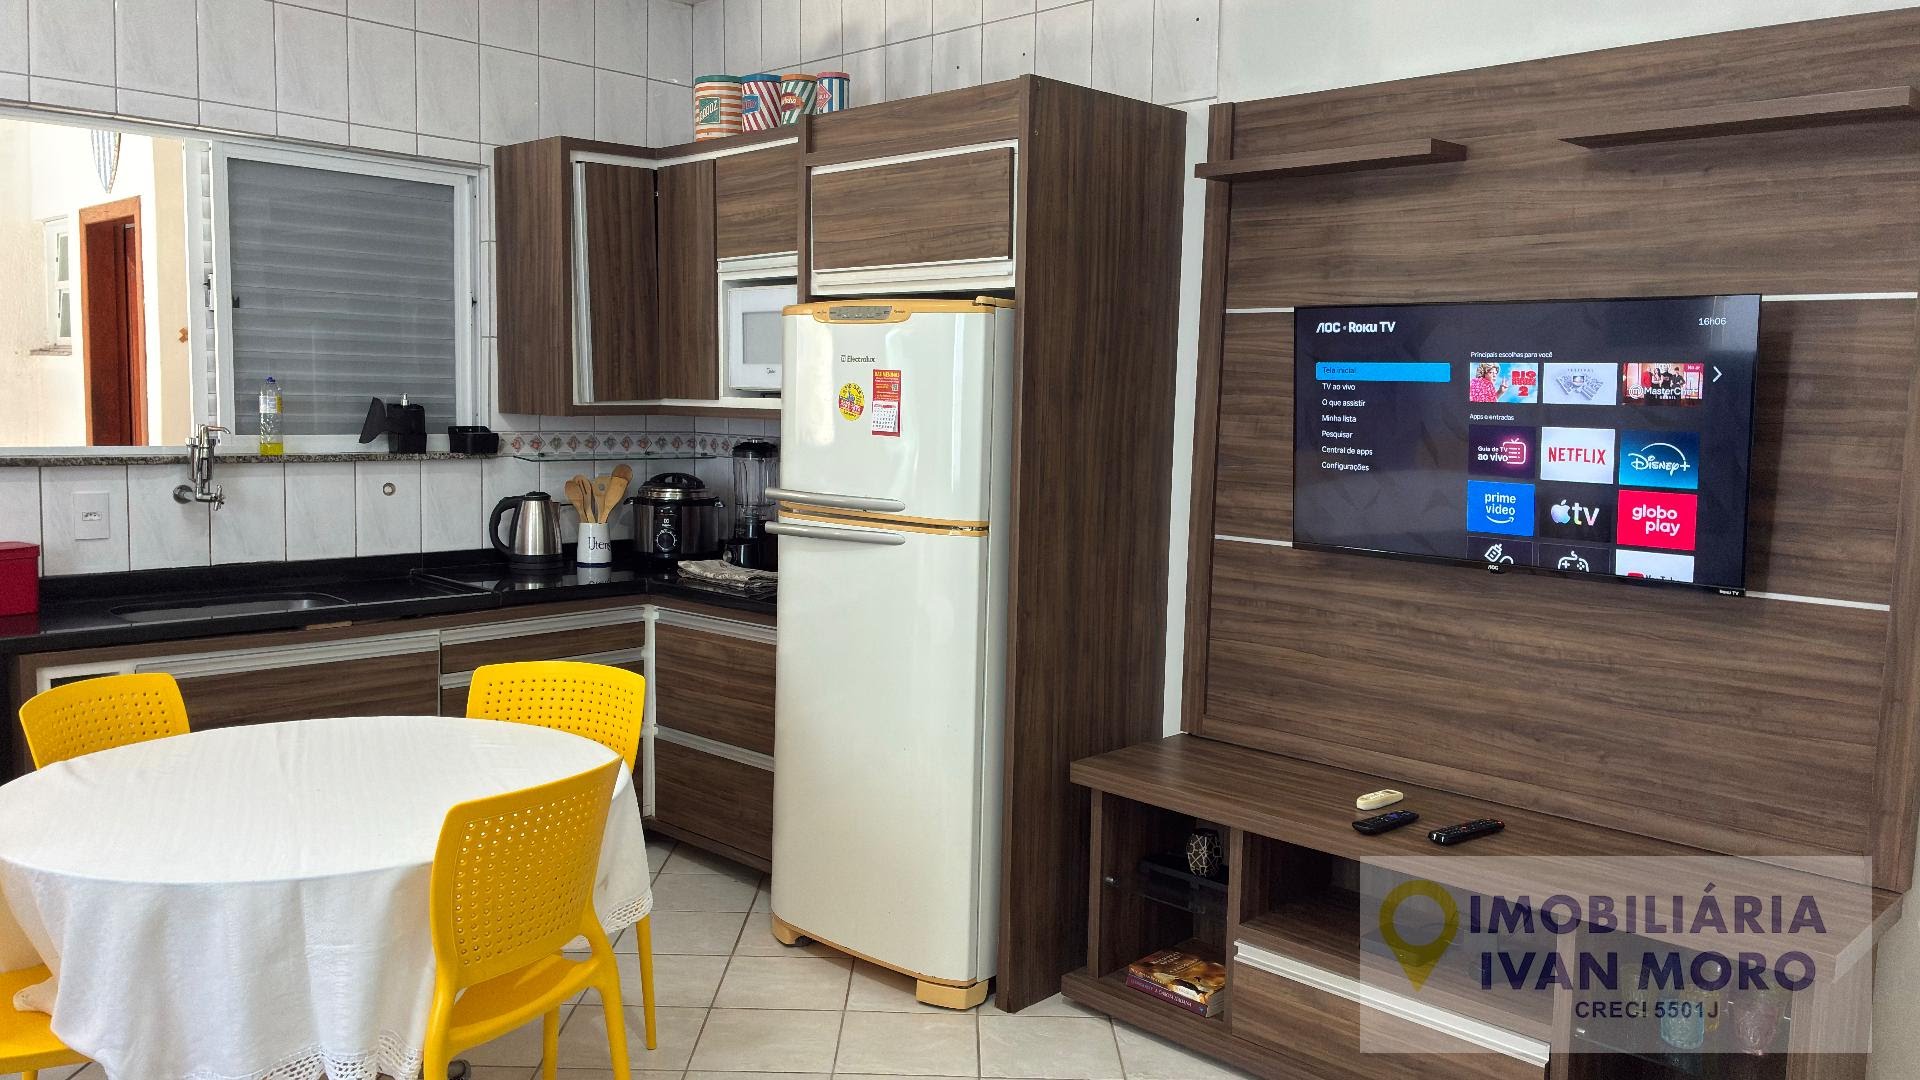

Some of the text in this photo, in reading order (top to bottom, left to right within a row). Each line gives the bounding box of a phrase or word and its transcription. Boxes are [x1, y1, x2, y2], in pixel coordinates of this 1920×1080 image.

[1698, 317, 1727, 326] 16h06
[1316, 321, 1397, 333] AOC Roku TV
[847, 355, 876, 363] Electrolux
[1470, 351, 1498, 359] Principais
[1323, 366, 1336, 374] Tela
[1322, 382, 1332, 391] TV
[1342, 383, 1356, 391] vivo
[1518, 385, 1529, 397] 2
[1644, 387, 1699, 396] MasterChef
[1321, 398, 1366, 408] O que assistir
[1321, 414, 1357, 423] Minha lista
[1470, 413, 1484, 421] Apps
[1321, 430, 1354, 439] Pesquisar
[1321, 445, 1373, 457] Central de apps
[1548, 446, 1606, 465] NETFLIX
[1477, 452, 1509, 462] ao vivo
[1321, 461, 1370, 472] Configurações
[1484, 492, 1517, 505] prime
[1485, 503, 1516, 516] video
[1571, 502, 1600, 526] tv
[1632, 504, 1678, 521] globo
[1645, 519, 1681, 536] play
